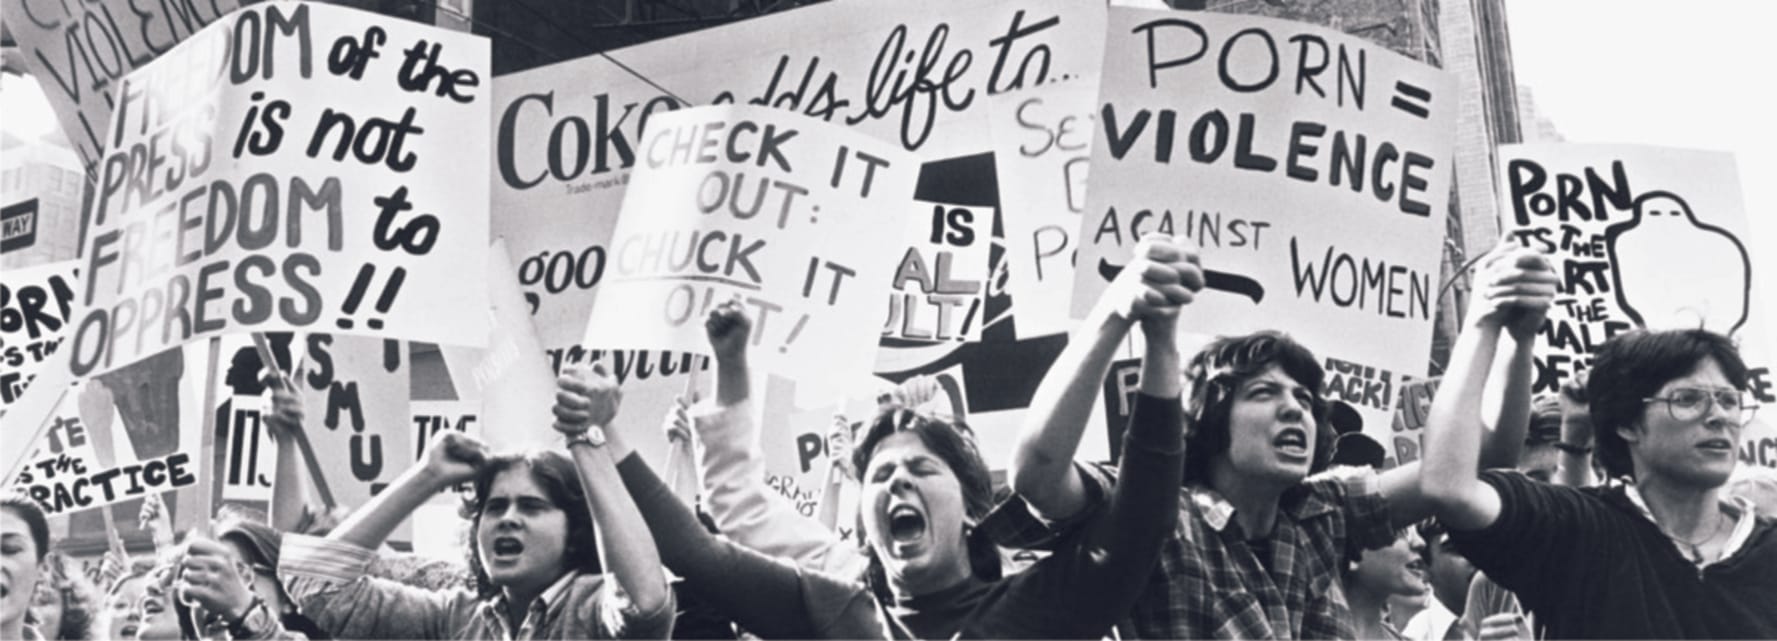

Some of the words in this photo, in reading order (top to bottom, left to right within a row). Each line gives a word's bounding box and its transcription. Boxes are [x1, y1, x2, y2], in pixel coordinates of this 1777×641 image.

[328, 26, 387, 80] of
[398, 40, 480, 103] the
[846, 23, 976, 151] life
[1132, 18, 1366, 110] PORN
[96, 105, 214, 226] PRESS
[233, 91, 291, 158] is
[306, 107, 424, 172] not
[647, 120, 799, 174] CHECK
[830, 145, 890, 198] IT
[1016, 98, 1094, 158] SE
[1101, 103, 1434, 217] VIOLENCE
[697, 170, 820, 230] OUT:
[931, 205, 975, 247] IS
[1508, 159, 1633, 226] PORN
[2, 215, 31, 239] WAY
[84, 173, 343, 306] FREEDOM
[373, 186, 440, 255] to
[1094, 206, 1270, 250] AGAINST
[1560, 224, 1606, 258] THE
[616, 229, 767, 284] CHUCK
[802, 256, 856, 306] IT
[1290, 236, 1430, 321] WOMEN
[1556, 259, 1609, 295] RT
[69, 254, 324, 377] OPPRESS
[1555, 298, 1609, 322] THE
[11, 453, 196, 512] RACTICE
[36, 454, 86, 479] THE
